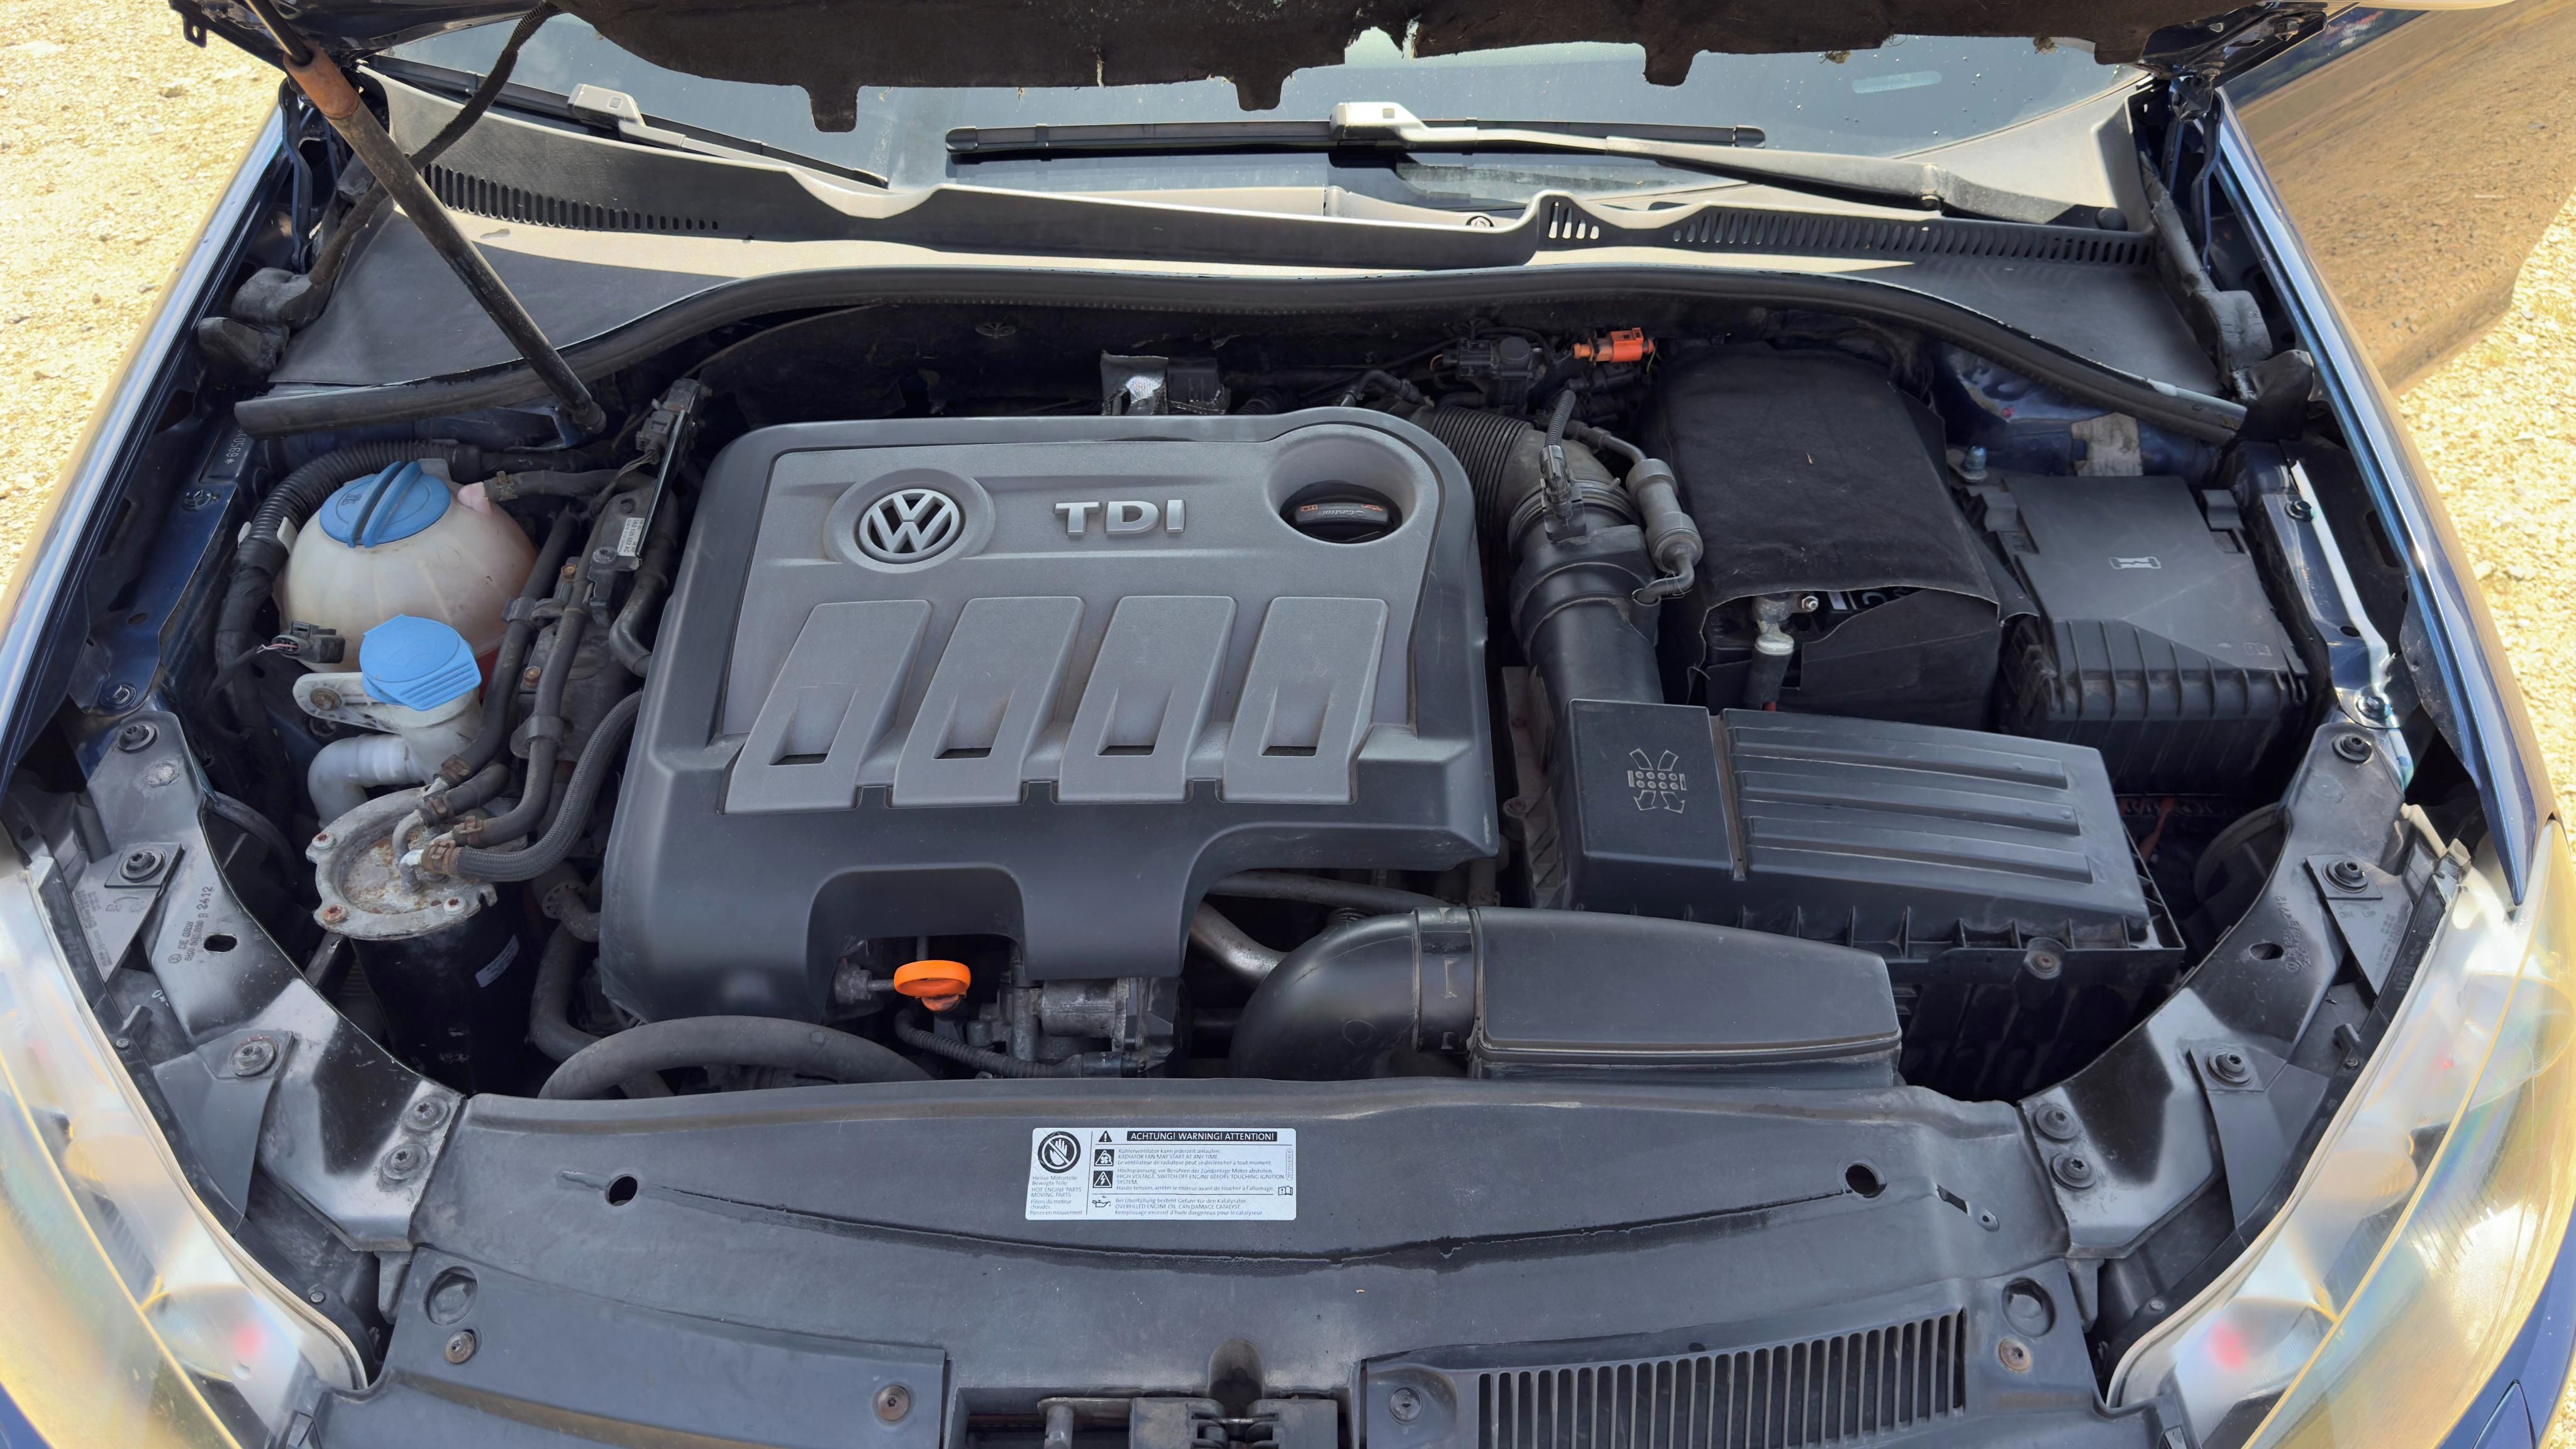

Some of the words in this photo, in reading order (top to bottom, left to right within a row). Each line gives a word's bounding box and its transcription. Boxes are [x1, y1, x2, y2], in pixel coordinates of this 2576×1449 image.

[859, 489, 960, 560] VW
[1054, 500, 1185, 536] TDI
[1131, 1132, 1175, 1140] ACHTUNG!
[1178, 1132, 1223, 1140] WARNING!
[1224, 1132, 1274, 1140] ATTENTION!
